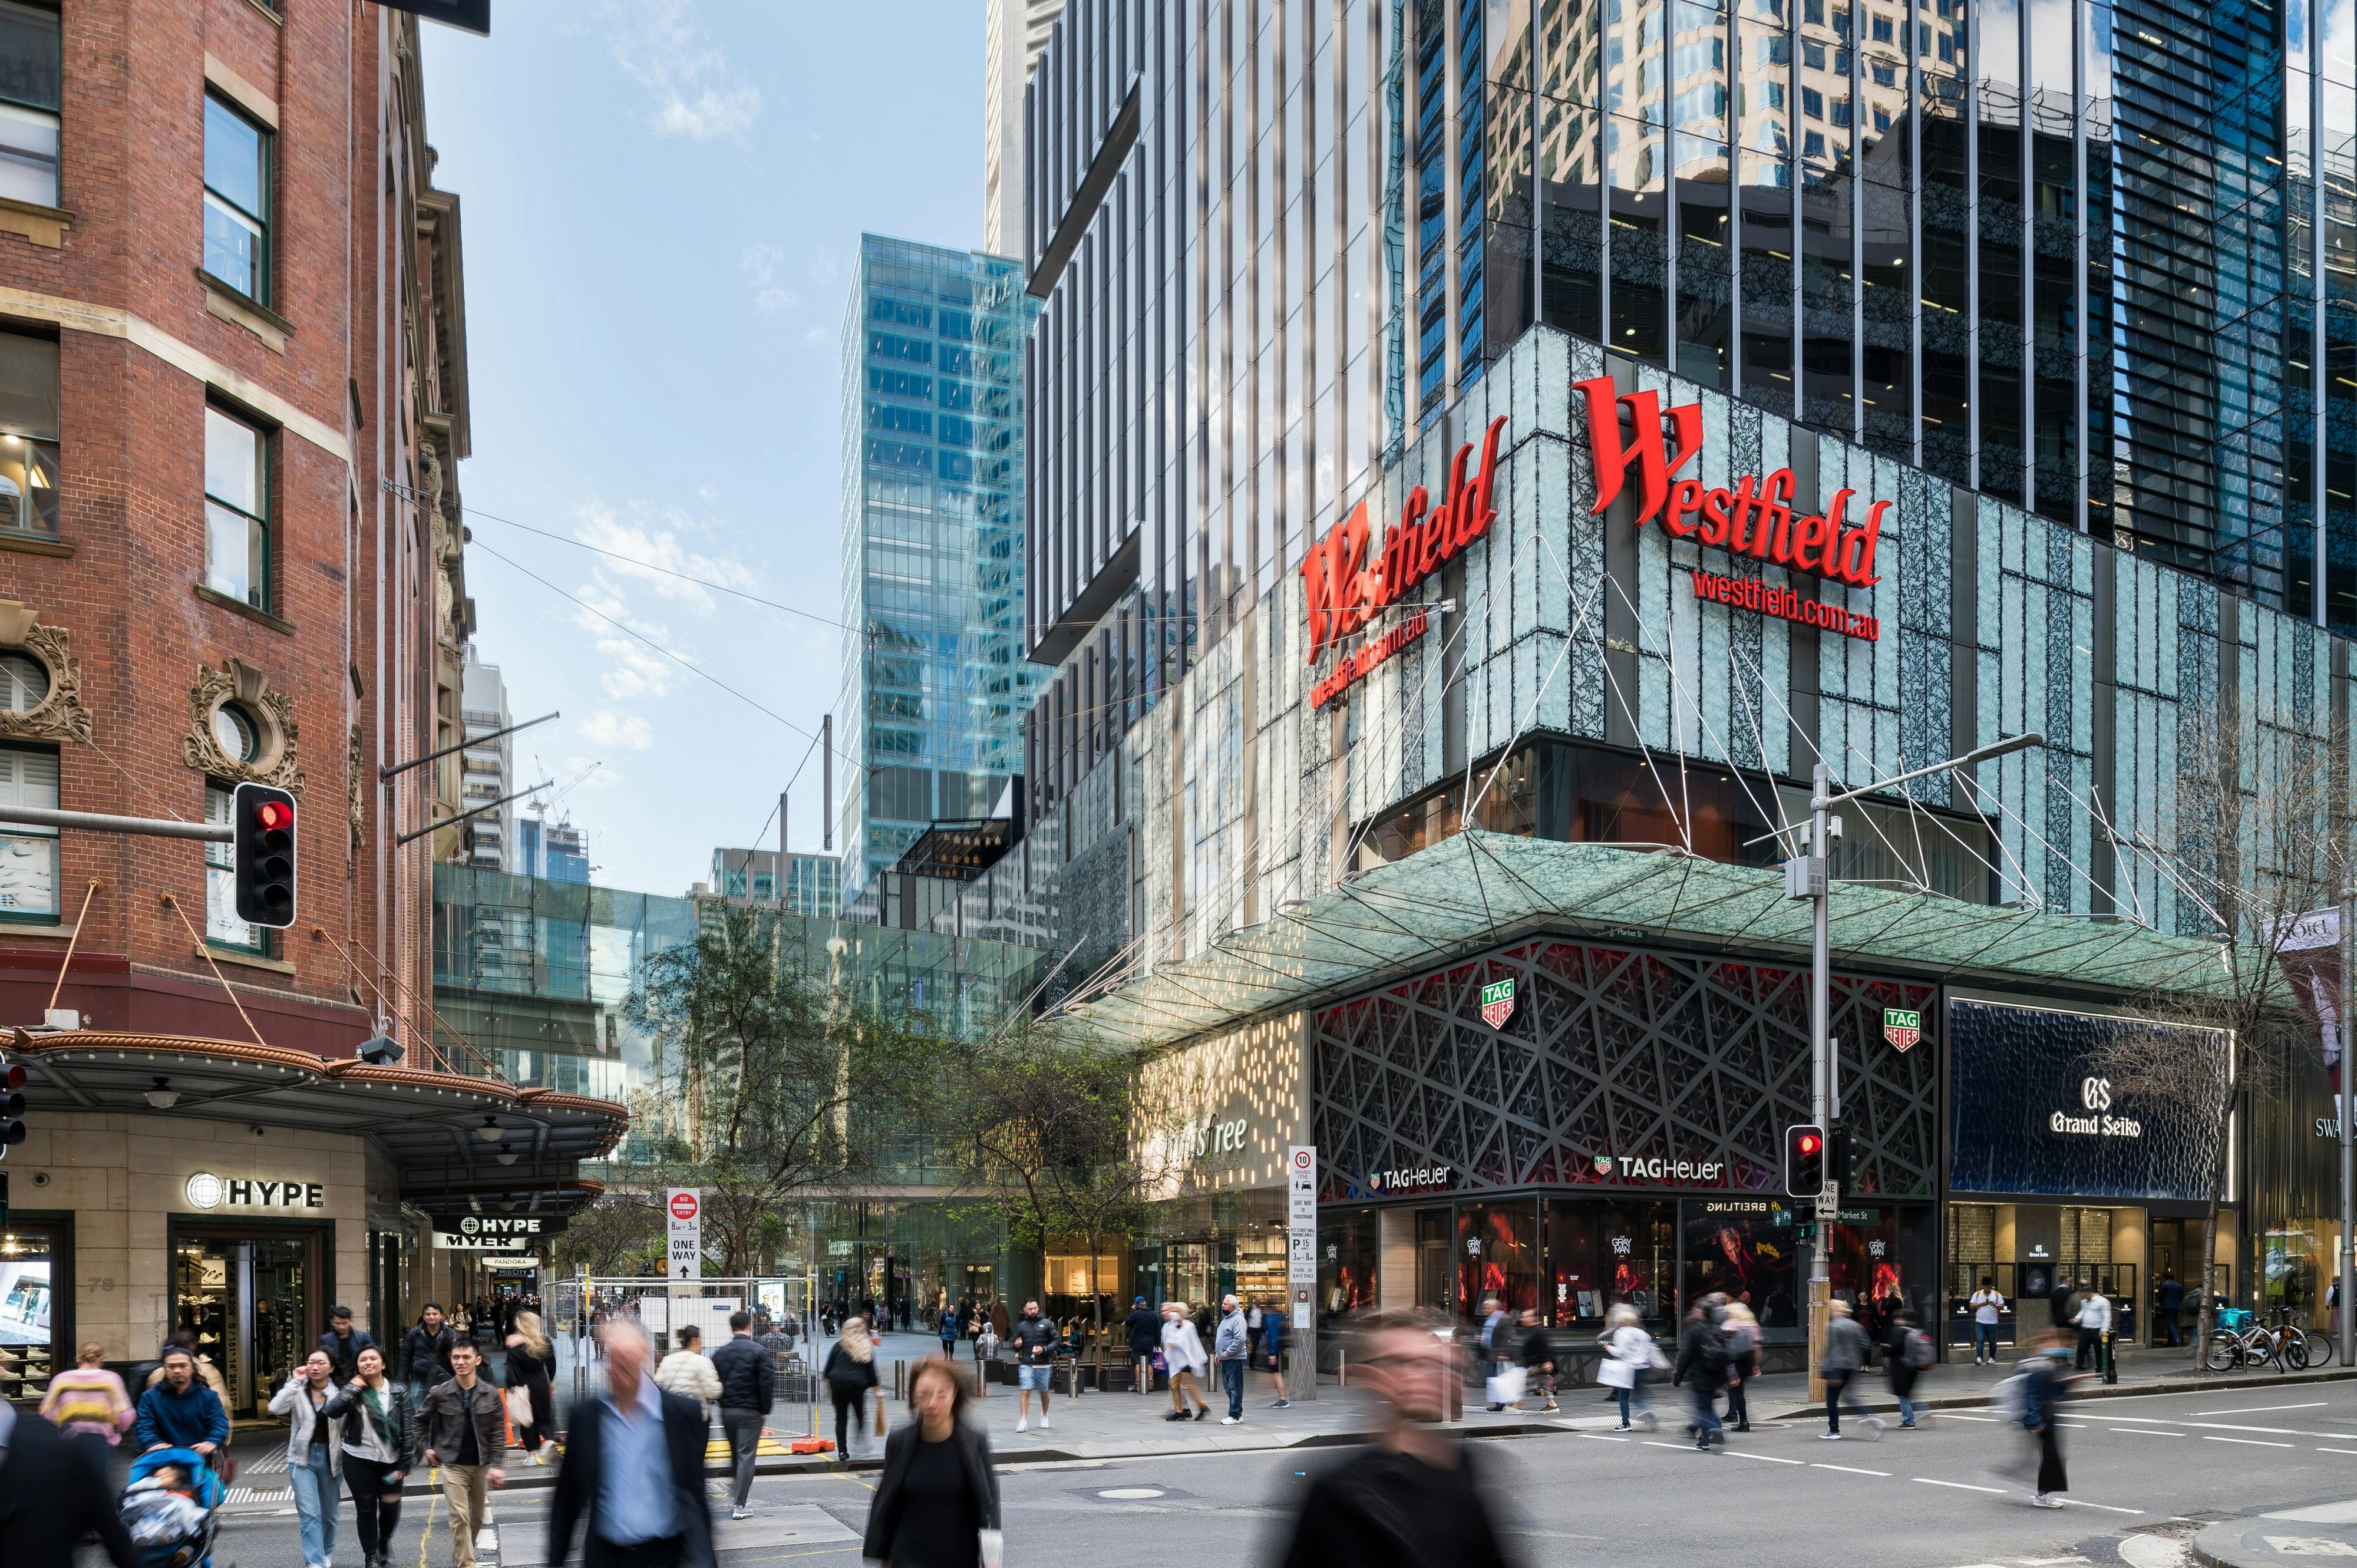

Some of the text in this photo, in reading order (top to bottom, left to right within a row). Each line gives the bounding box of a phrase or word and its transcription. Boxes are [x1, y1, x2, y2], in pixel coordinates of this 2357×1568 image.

[1571, 375, 1893, 589] Westfield
[1299, 415, 1508, 665] Westfield
[1692, 571, 1880, 642] westfield.com.au
[1485, 982, 1511, 1002] TAG
[1484, 1002, 1512, 1025] HEUER
[1887, 1011, 1916, 1026] TAG
[1887, 1028, 1917, 1049] HEUER
[2081, 1077, 2111, 1111] GS
[2049, 1111, 2141, 1137] Grand Seiko
[1595, 1164, 1610, 1174] HEUER
[225, 1179, 323, 1207] HYPE
[1824, 1184, 1835, 1193] NE
[1818, 1196, 1836, 1205] WAY
[1838, 1211, 1860, 1219] Market
[483, 1219, 541, 1232] HYPE
[446, 1236, 511, 1247] MYER
[674, 1240, 694, 1249] ONE
[1293, 1239, 1300, 1250] P
[1467, 1239, 1481, 1247] GRAY
[1612, 1238, 1632, 1246] GRAY
[672, 1251, 696, 1260] WAY
[1469, 1246, 1480, 1255] MAN
[1614, 1245, 1630, 1254] MAN
[88, 1277, 114, 1292] 78
